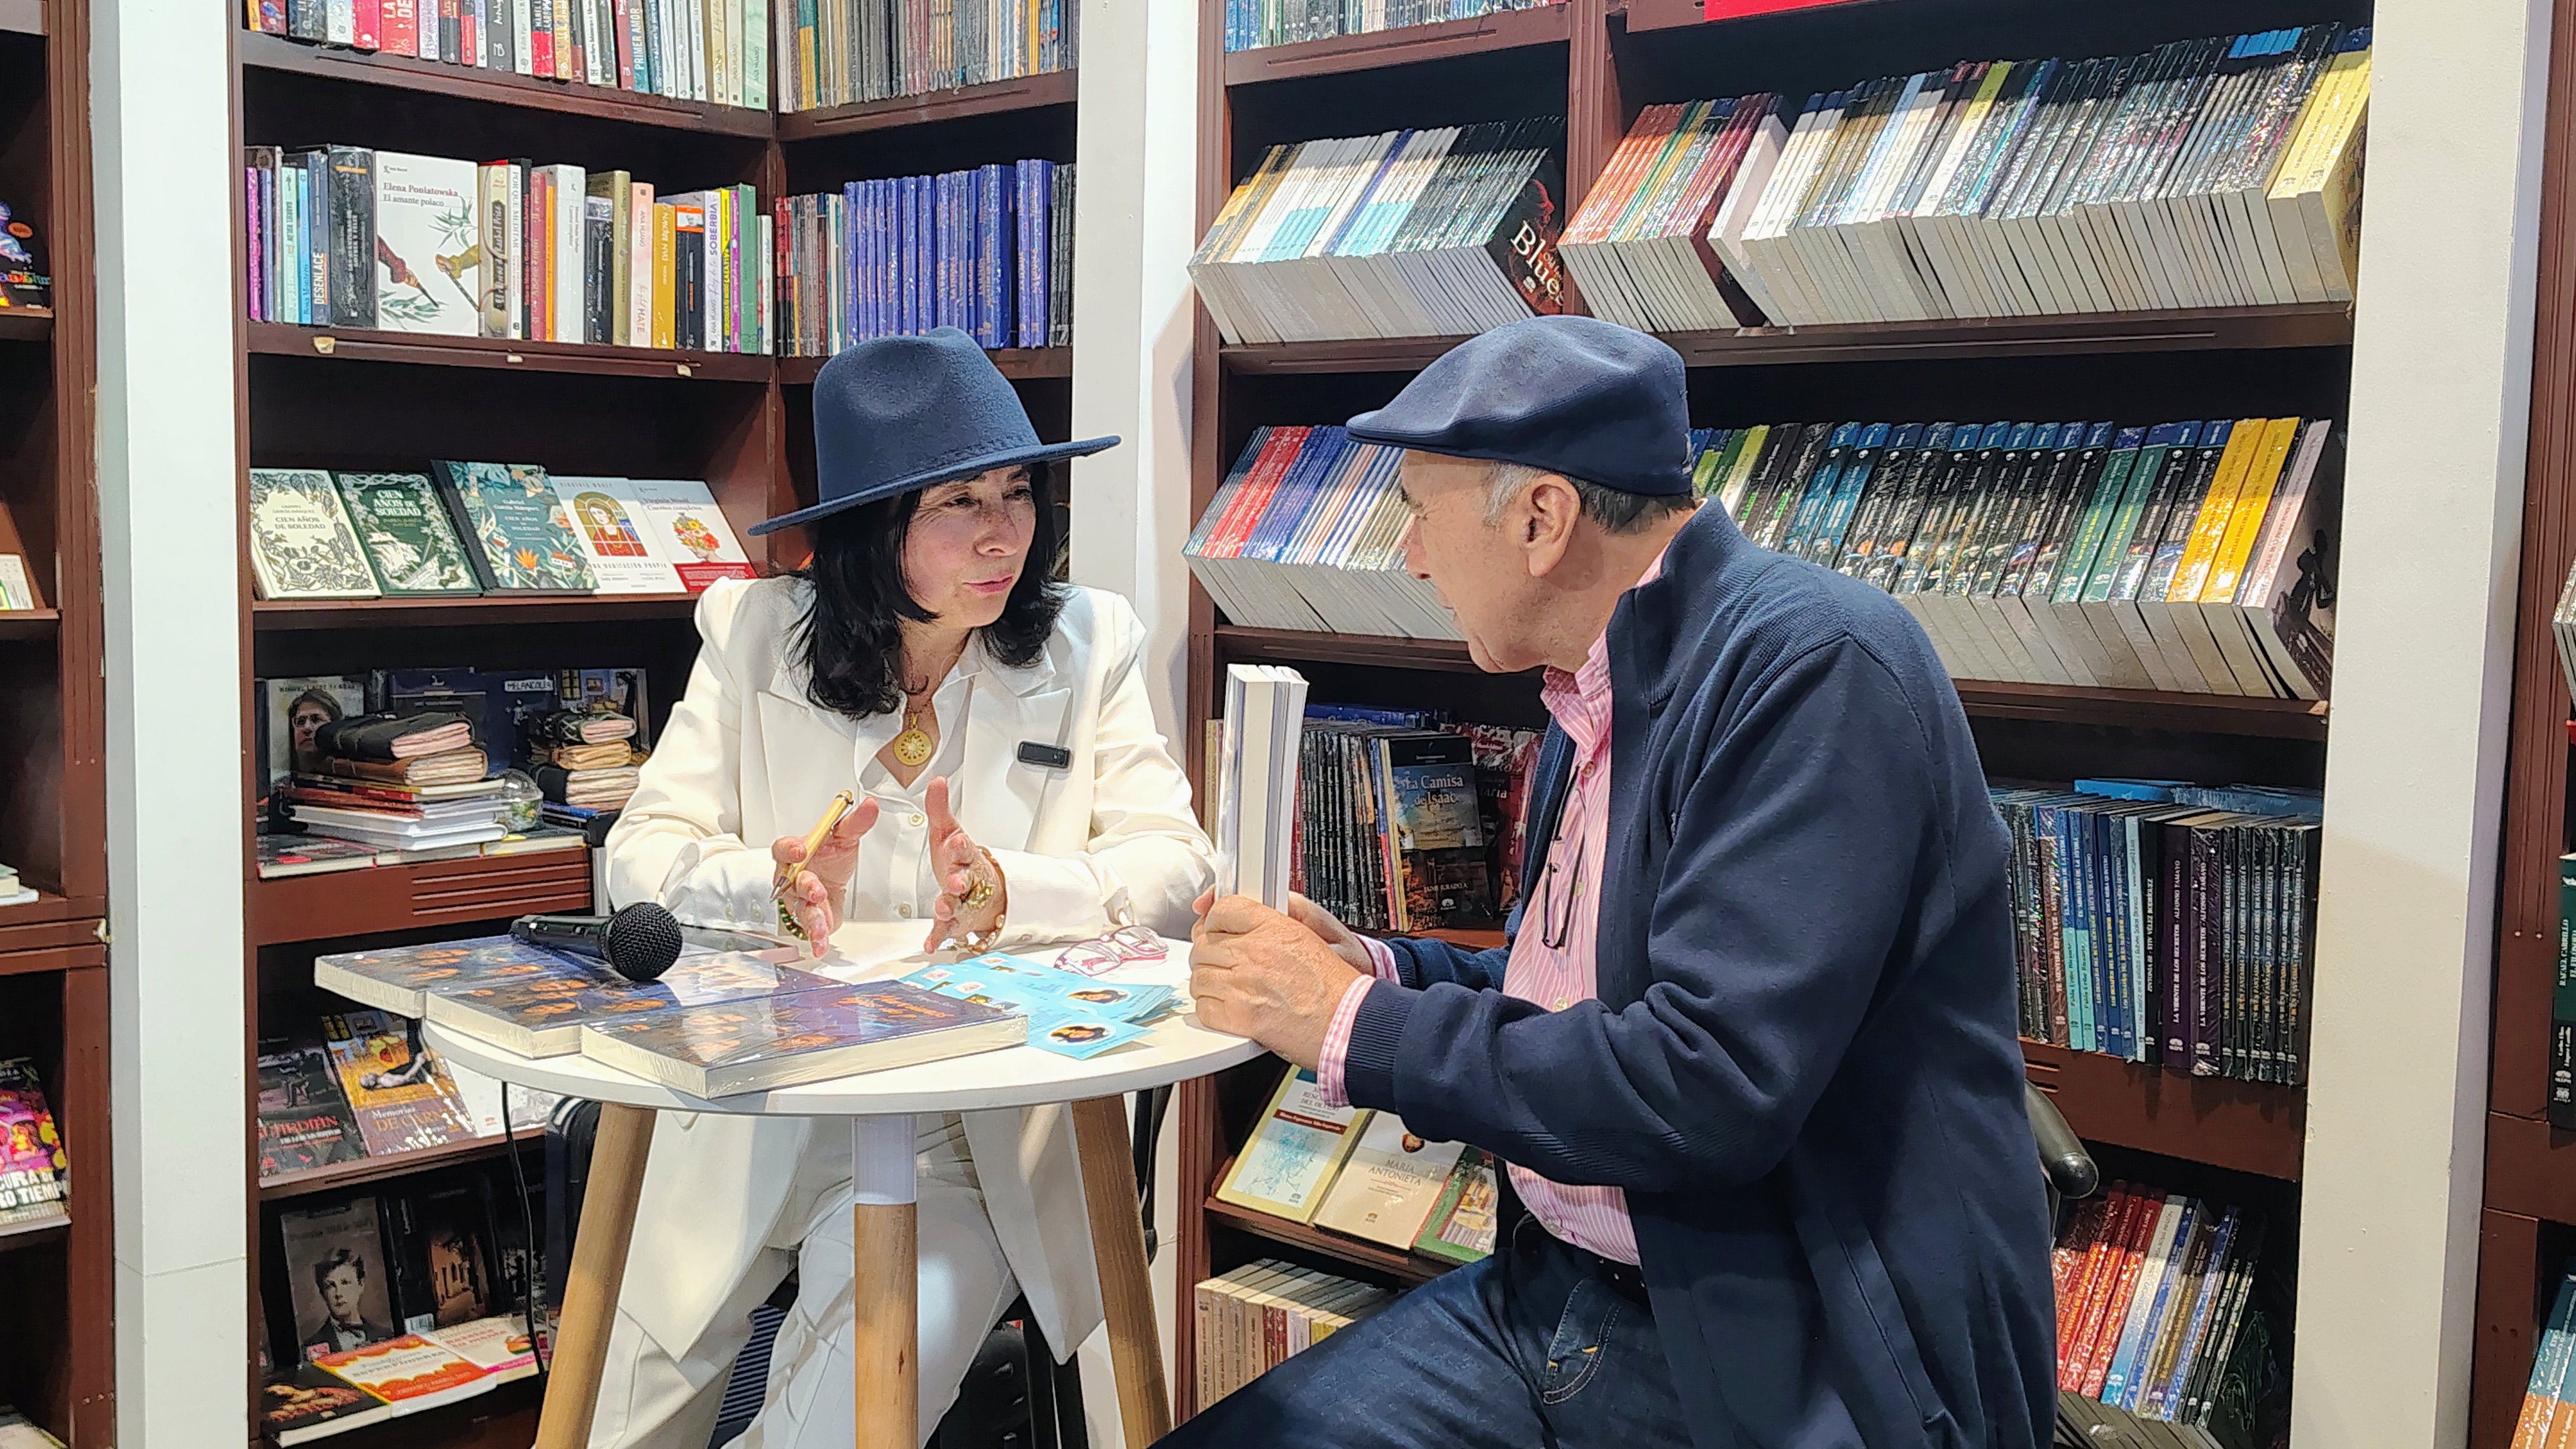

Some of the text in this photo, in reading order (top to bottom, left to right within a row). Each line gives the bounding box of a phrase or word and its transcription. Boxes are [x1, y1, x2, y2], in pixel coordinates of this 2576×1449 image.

[630, 8, 645, 70] PRIMER AMOR
[511, 171, 519, 189] POR
[382, 182, 458, 197] Elena Poniatowska
[382, 193, 445, 208] El amante polaco
[511, 209, 519, 249] MEDITAR
[662, 213, 670, 242] BROWN
[709, 203, 718, 255] SOBERBIA
[312, 252, 325, 305] DESENLACE
[636, 308, 646, 333] HATE
[376, 489, 403, 499] CIEN
[373, 499, 403, 508] AÑOS
[375, 507, 421, 517] SOLEDAD
[1405, 774, 1464, 790] La Camisa
[1414, 791, 1457, 806] de Isaac
[2145, 877, 2153, 914] RODRÍGUEZ
[2558, 919, 2569, 986] RAFAEL CARRILLO
[2053, 950, 2062, 982] MENTIRÉ
[1300, 1097, 1313, 1106] DEL
[370, 1106, 416, 1120] Memorias
[374, 1116, 399, 1132] DE
[1384, 1158, 1414, 1174] MARÍA
[1368, 1165, 1421, 1186] ANTONIETA
